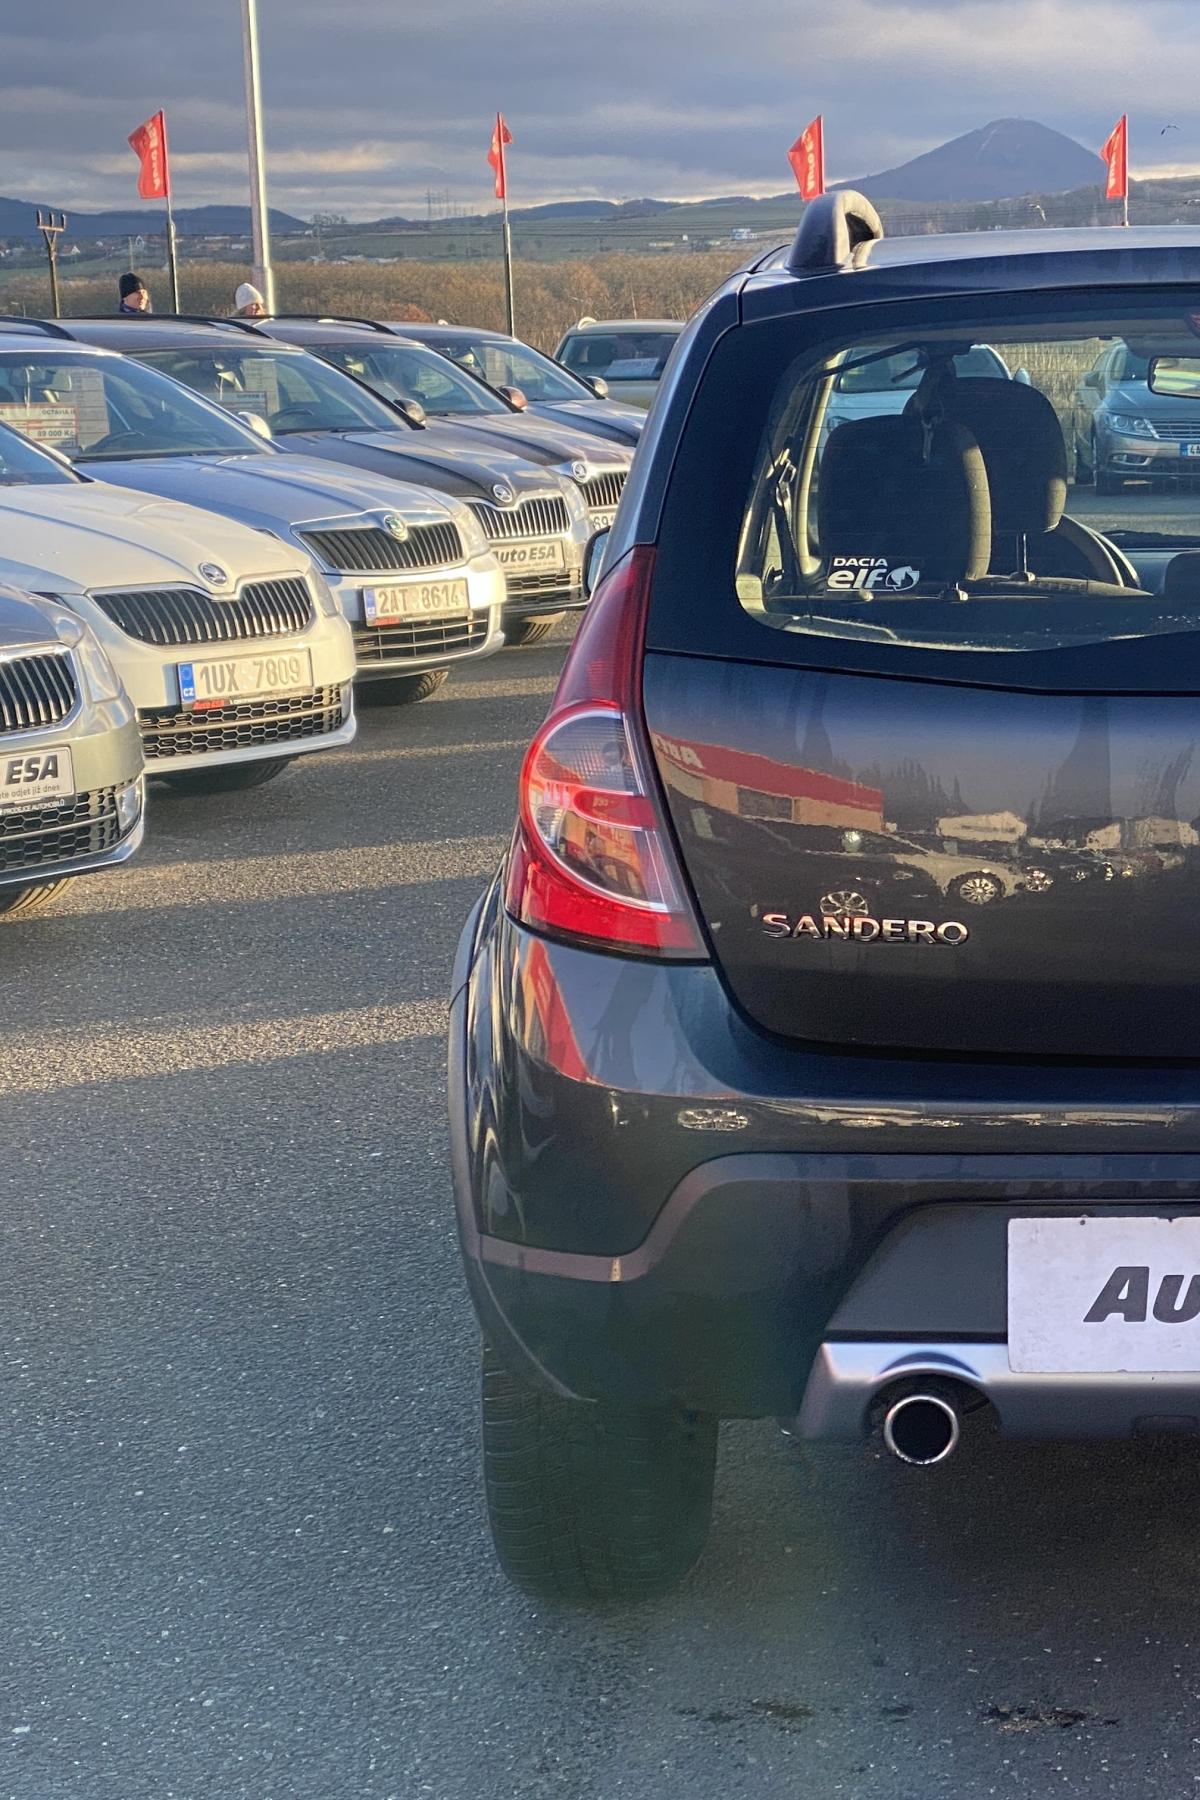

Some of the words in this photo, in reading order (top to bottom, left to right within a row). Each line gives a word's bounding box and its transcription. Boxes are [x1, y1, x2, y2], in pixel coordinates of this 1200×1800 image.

[529, 545, 556, 560] ESA
[833, 557, 888, 567] DACIA
[827, 568, 887, 589] elf
[379, 589, 408, 614] 2AT
[421, 583, 460, 609] 8614
[200, 663, 240, 695] 1UX
[253, 656, 301, 688] 7809
[183, 687, 195, 697] CZ
[5, 754, 59, 785] ESA
[762, 913, 969, 945] SANDERO
